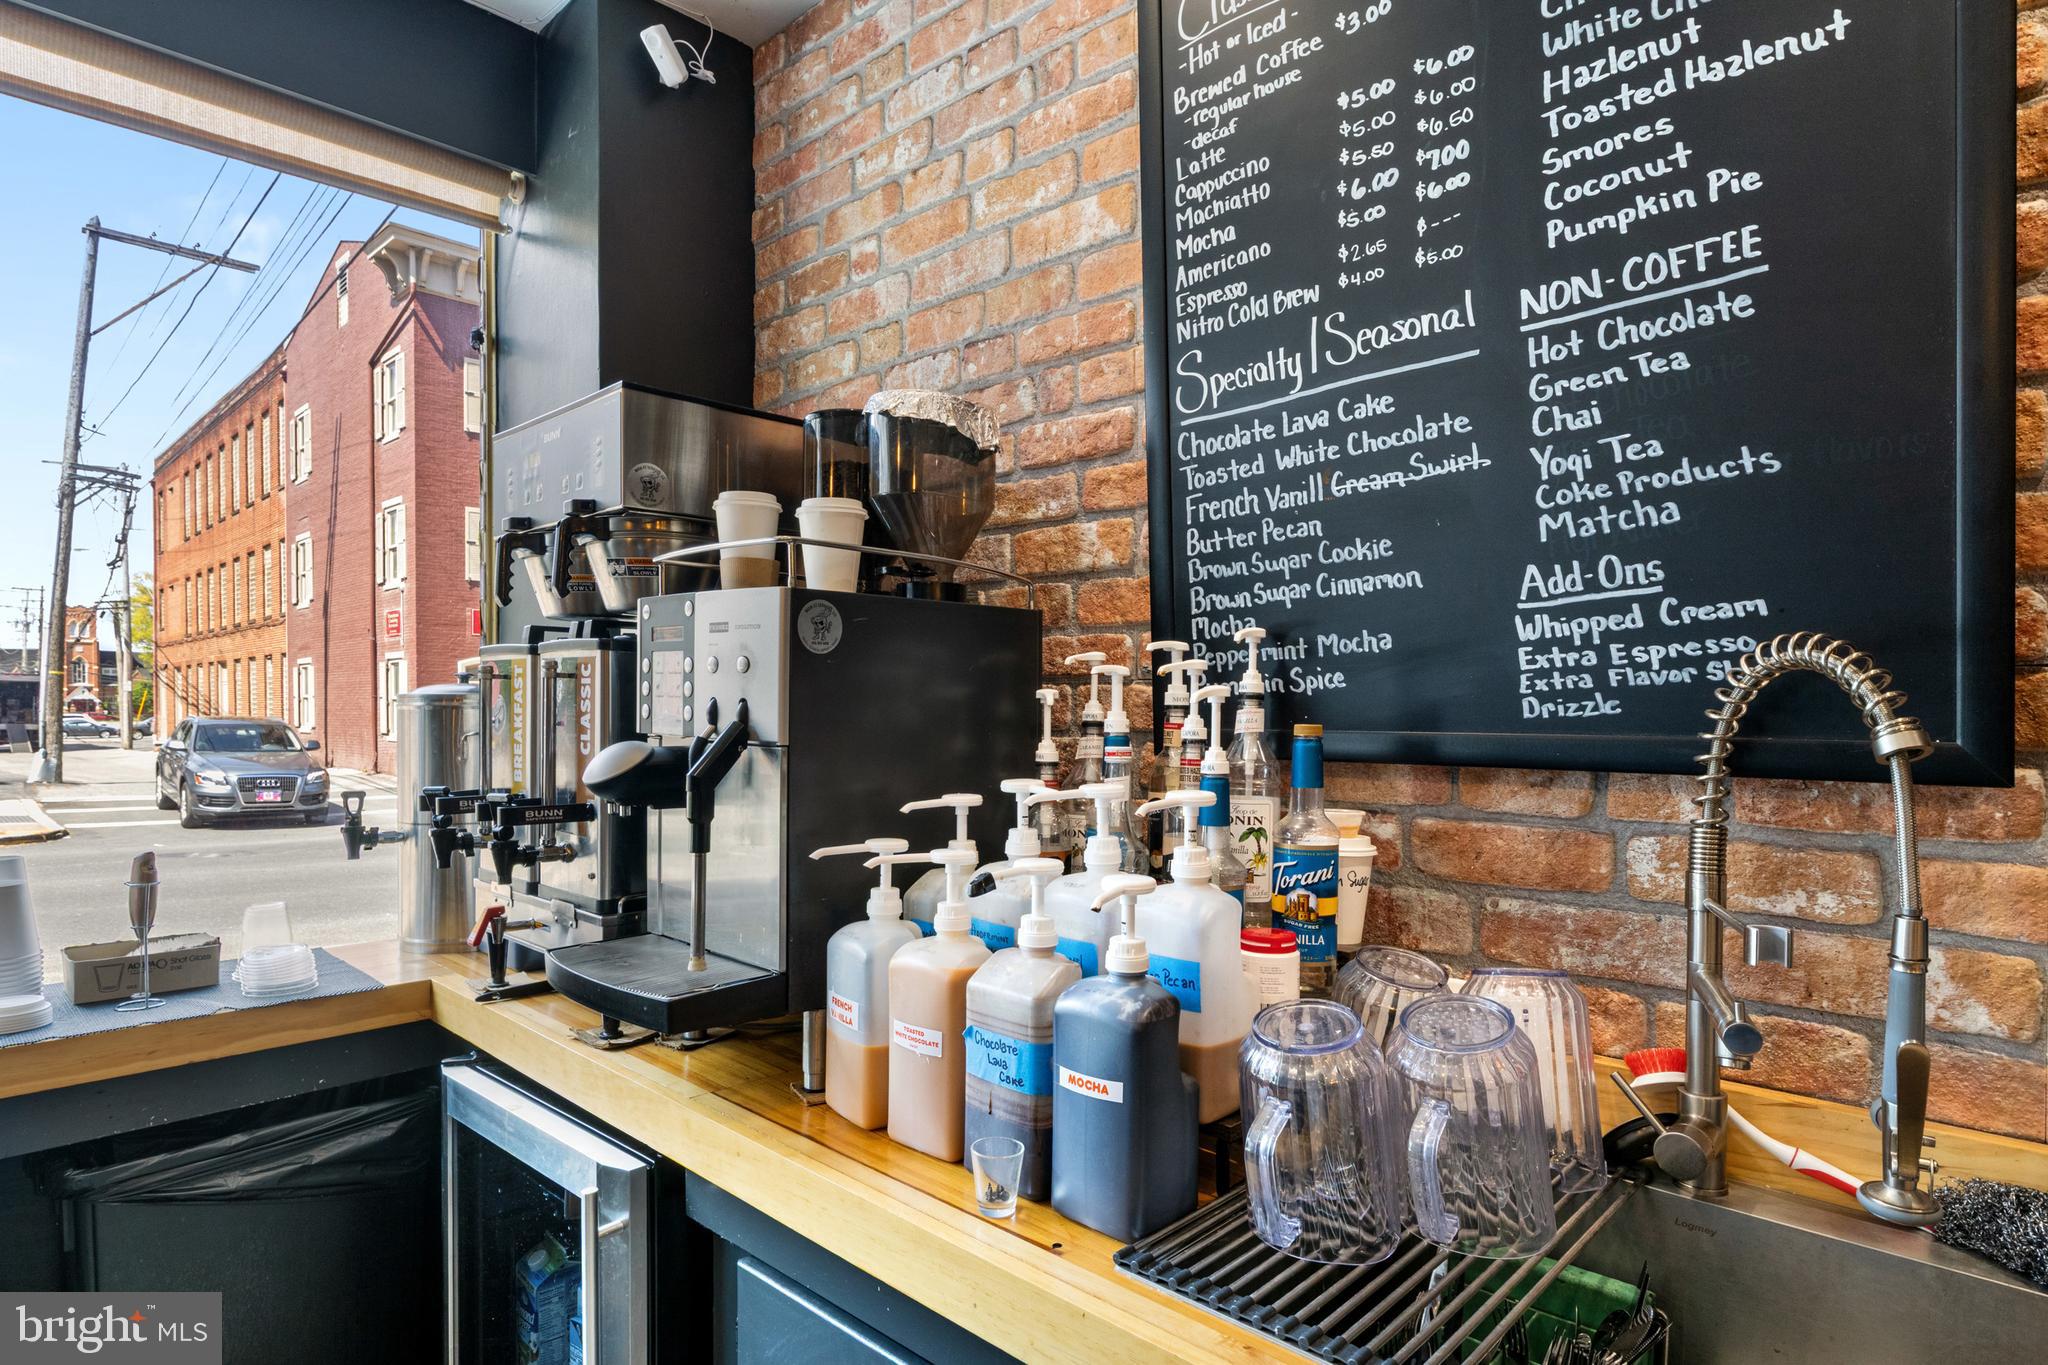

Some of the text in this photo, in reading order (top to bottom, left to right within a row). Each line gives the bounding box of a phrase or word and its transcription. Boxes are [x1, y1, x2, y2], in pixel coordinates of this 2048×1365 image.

[1335, 0, 1392, 35] $3.00
[1542, 7, 1643, 57] White
[1227, 33, 1241, 49] or
[1173, 36, 1324, 115] Brewed Coffee
[1413, 45, 1474, 74] $6.00
[1541, 9, 1851, 138] Toasted Hazlenut
[1543, 18, 1701, 103] Hazlenut
[1254, 68, 1303, 100] house
[1336, 79, 1396, 109] $5.00
[1414, 77, 1476, 104] $6.00
[1339, 111, 1396, 137] $5.00
[1417, 107, 1474, 135] $6.50
[1176, 146, 1226, 181] Latte
[1340, 142, 1394, 166] $5.50
[1542, 117, 1674, 175] Smores
[1175, 157, 1271, 208] Cappuccino
[1337, 167, 1399, 201] $6.00
[1415, 172, 1471, 202] $6.00
[1544, 141, 1692, 210] Coconut
[1176, 182, 1271, 232] Machiatto
[1338, 204, 1386, 227] $5.00
[1546, 168, 1763, 248] Pumpkin Pie
[1175, 225, 1237, 260] Mocha
[1338, 240, 1387, 263] $2.65
[1414, 244, 1463, 268] $5.00
[1175, 241, 1272, 291] Americano
[1338, 267, 1385, 288] $4.00
[1176, 281, 1248, 318] Espresso
[1176, 284, 1320, 344] Nitro Cold Brew
[1528, 290, 1755, 368] Hot Chocolate
[1529, 366, 1628, 402] Green
[1629, 351, 1691, 377] Tea
[1177, 393, 1395, 461] Chocolate Lava Cake
[1531, 401, 1602, 436] Chai
[1179, 412, 1473, 490] Toasted White Chocolate
[1597, 433, 1664, 463] Tea
[1535, 481, 1612, 509] Coke
[1616, 446, 1782, 495] Products
[1185, 487, 1260, 525] French
[1539, 500, 1681, 542] Matcha
[1186, 518, 1323, 556] Butter Pecan
[1188, 537, 1393, 583] Brown Sugar Cookie
[1520, 554, 1665, 600] Add-Ons
[1189, 570, 1423, 615] Brown Sugar Cinnamon
[1191, 614, 1256, 640] Mocha
[1515, 597, 1768, 645] Whipped Cream
[1193, 629, 1392, 673] Peppemint Mocha
[1518, 635, 1757, 671] Extra Espresso
[1290, 667, 1346, 695] Spice
[1519, 671, 1594, 694] Extra
[1608, 665, 1698, 687] Flavor
[513, 664, 523, 782] BREAKFAST
[580, 663, 591, 755] CLASSIC
[1522, 692, 1621, 719] Drizzle
[525, 810, 563, 818] BUNN
[1273, 859, 1336, 897] Torani
[1283, 918, 1302, 928] SUGAR
[1296, 934, 1326, 946] NILLA
[1161, 968, 1196, 991] Pecan
[831, 996, 853, 1014] FRENCH
[831, 1008, 854, 1026] VANILLA
[974, 1030, 1019, 1057] Chocolate
[987, 1053, 1009, 1071] Lava
[1000, 1071, 1025, 1088] Cake
[1068, 1074, 1109, 1096] MOCHA
